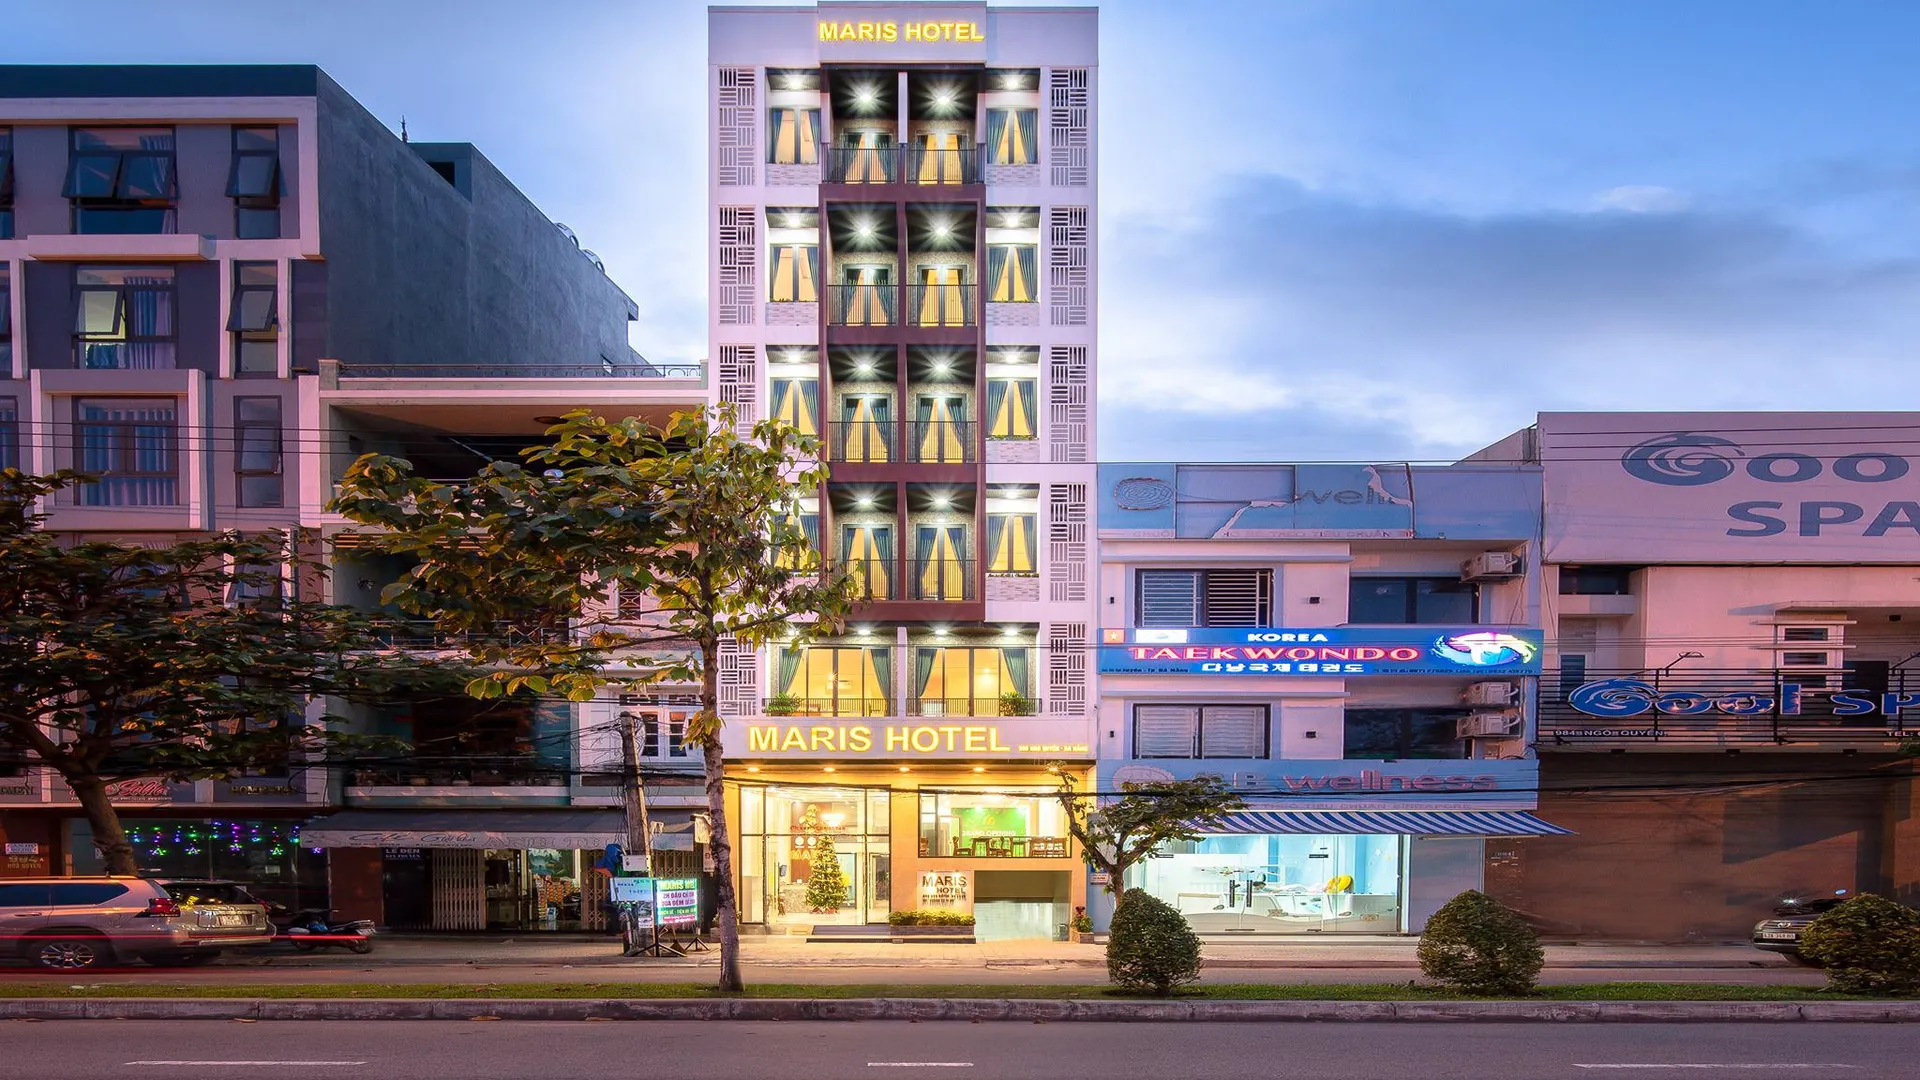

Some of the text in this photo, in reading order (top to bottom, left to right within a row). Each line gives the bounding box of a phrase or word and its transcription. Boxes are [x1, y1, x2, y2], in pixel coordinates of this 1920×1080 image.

[819, 21, 985, 41] MARIS HOTEL
[1726, 501, 1920, 537] SPA
[1247, 633, 1329, 642] KOREA
[1128, 646, 1421, 662] TAEKWONDO
[749, 726, 873, 751] MARIS
[886, 726, 1010, 751] HOTEL
[1283, 769, 1498, 791] wellness
[922, 876, 967, 887] MARIS
